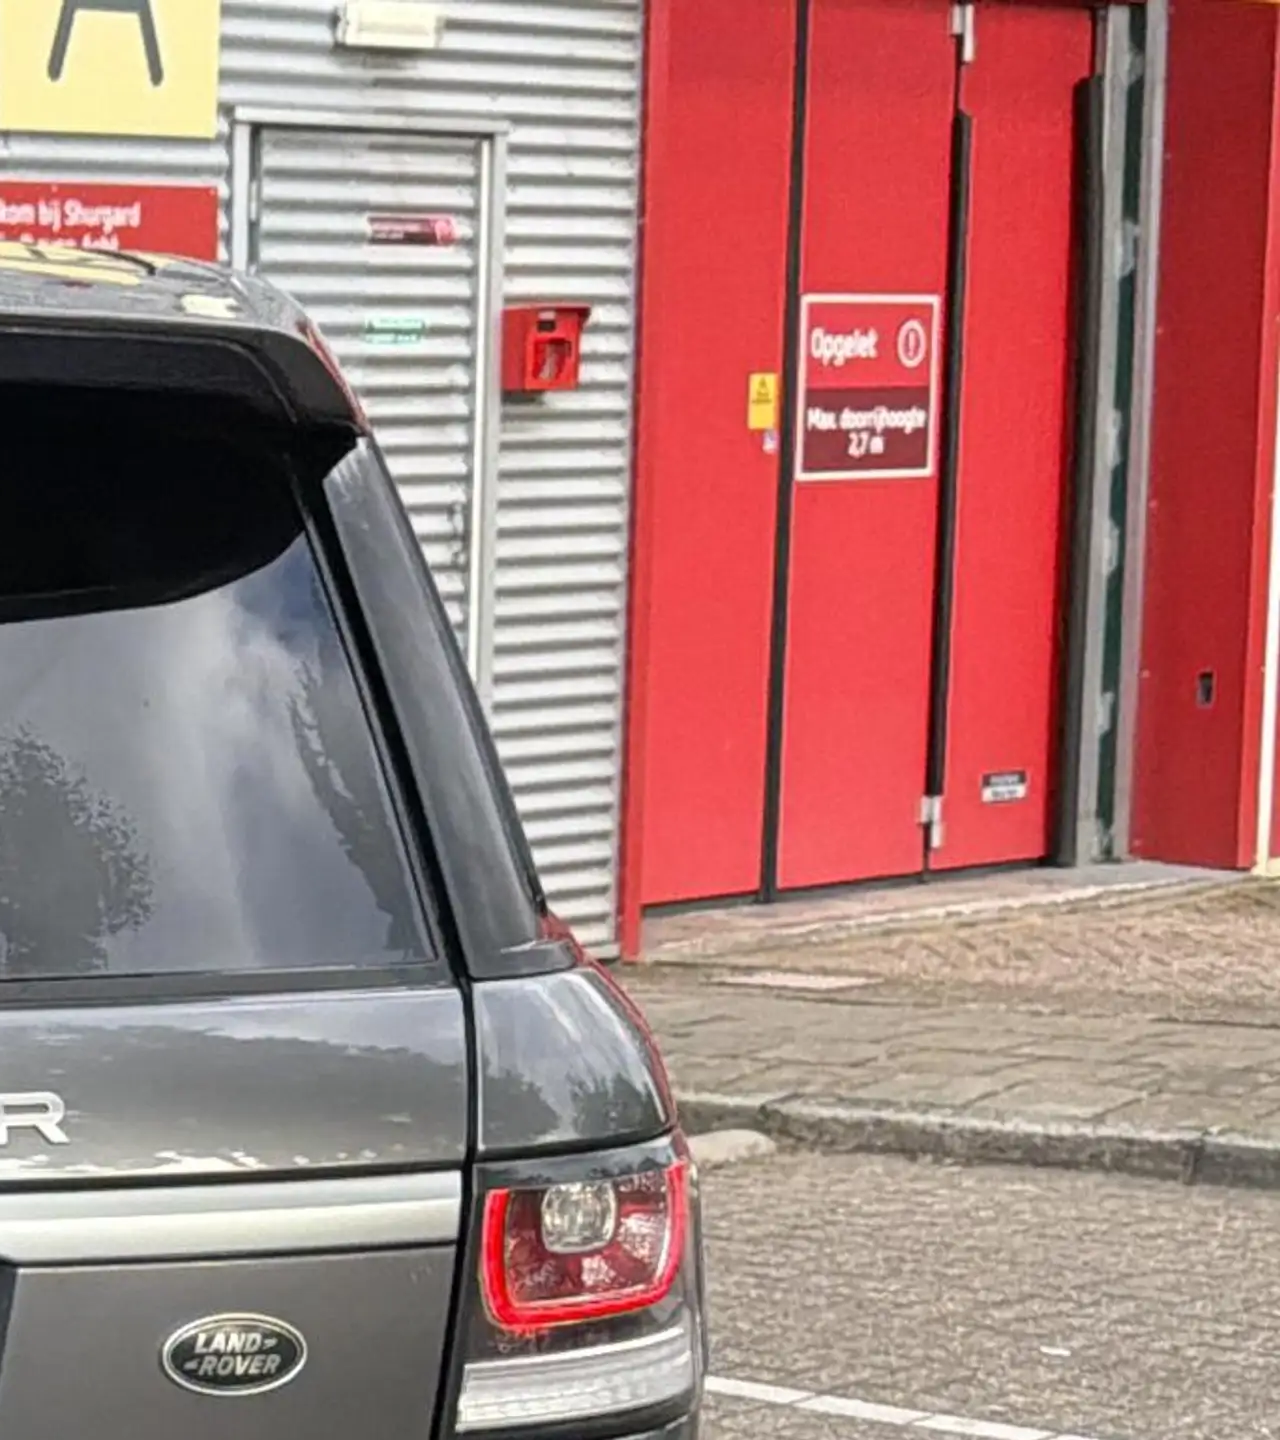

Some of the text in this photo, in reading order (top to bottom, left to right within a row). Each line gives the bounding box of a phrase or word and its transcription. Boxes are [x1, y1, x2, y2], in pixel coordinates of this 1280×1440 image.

[38, 198, 62, 233] bij
[64, 199, 141, 233] Shurgard
[810, 327, 878, 367] Opgelet
[194, 1331, 262, 1354] LAND
[198, 1354, 282, 1377] ROVER
